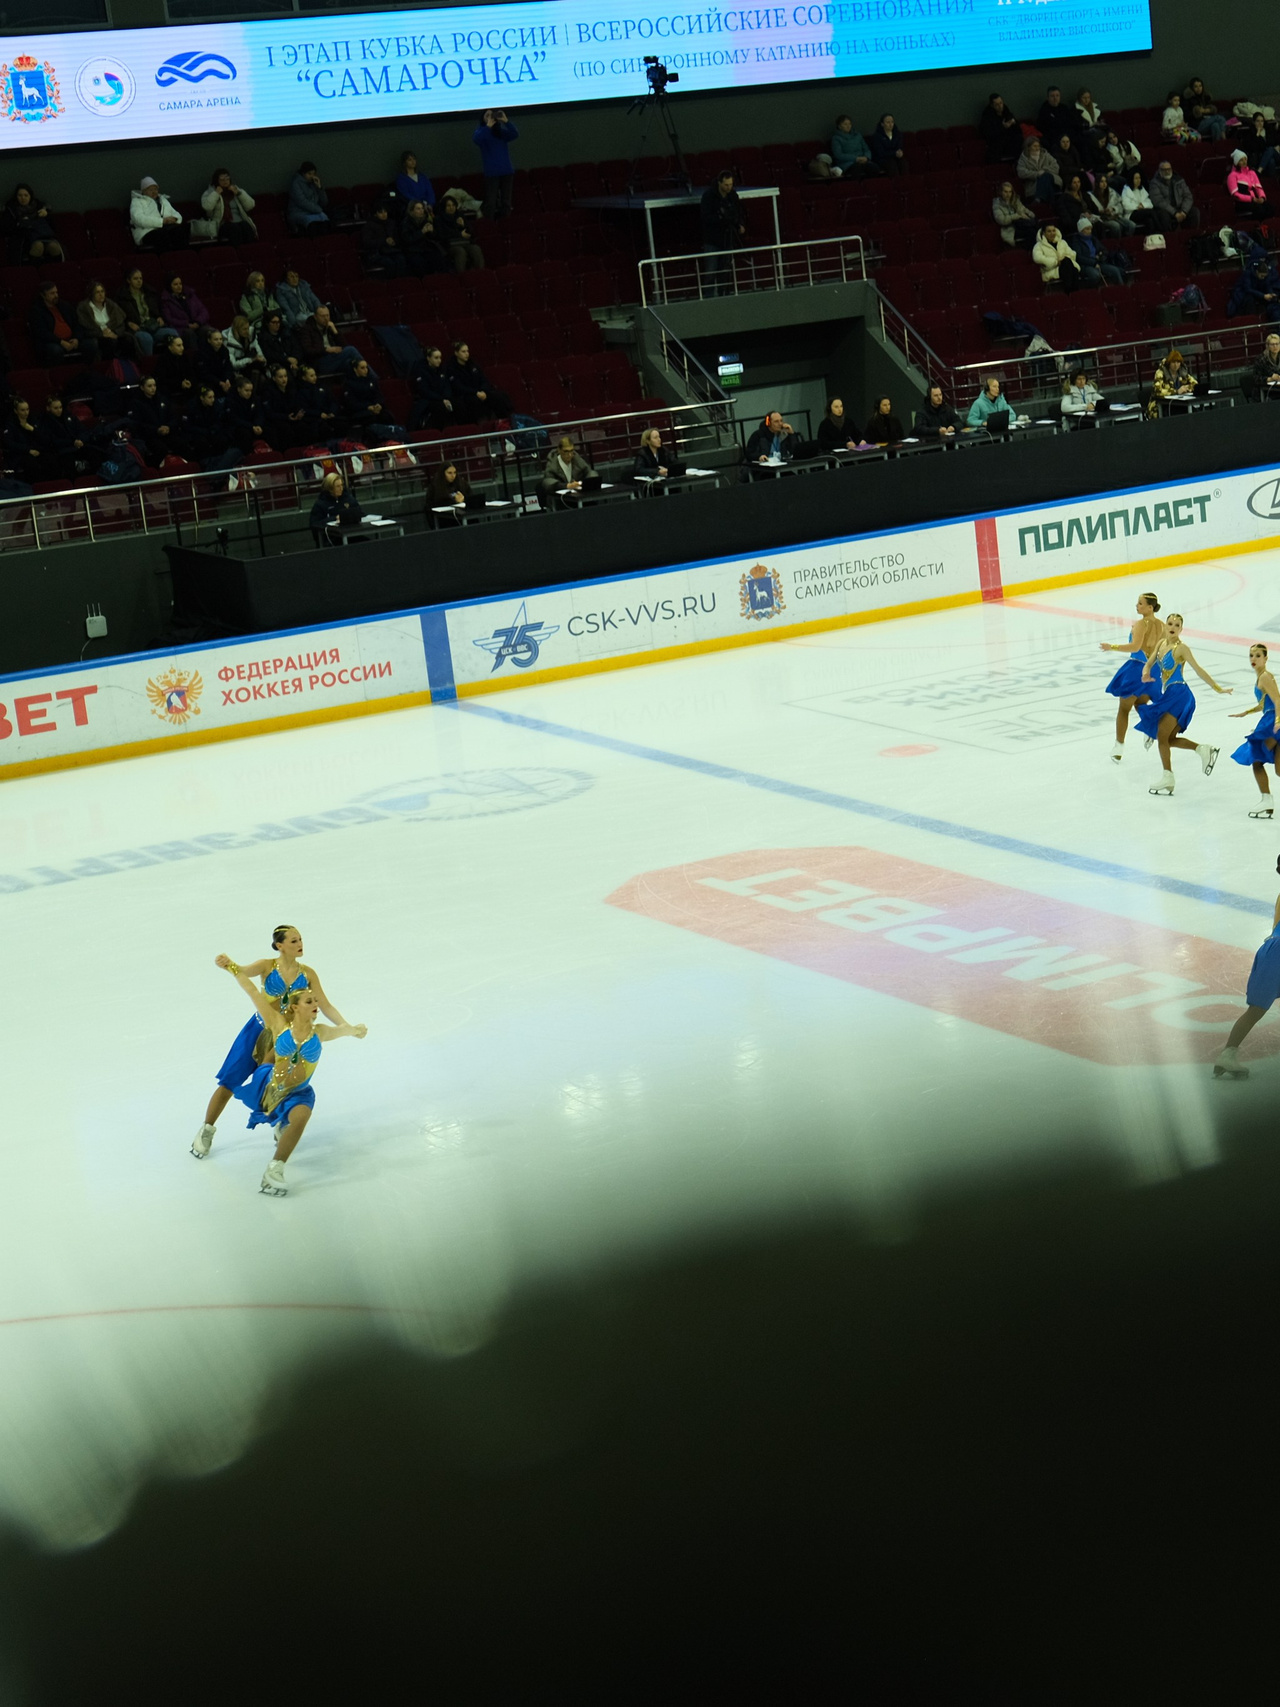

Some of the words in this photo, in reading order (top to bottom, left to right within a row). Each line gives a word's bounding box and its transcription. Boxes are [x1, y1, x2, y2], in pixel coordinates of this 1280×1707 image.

[576, 7, 787, 44] ВСЕРОССИЙСКИЕ
[793, 0, 975, 26] СОРЕВНОВАНИЯ
[1103, 4, 1143, 16] ИМЕНИ
[282, 40, 351, 65] ЭТАП
[360, 34, 445, 60] КУБКА
[451, 25, 557, 52] РОССИИ
[573, 58, 605, 79] (ПО
[610, 48, 750, 75] СИНРОННОМУ
[755, 40, 840, 62] КАТАНИЮ
[846, 39, 870, 55] НА
[874, 30, 956, 52] КОНЬКАХ)
[998, 28, 1066, 42] ВЛАДИМИРА
[159, 99, 204, 111] САМАРА
[206, 96, 242, 107] АРЕНА
[1018, 494, 1211, 556] ПОЛИПЛАСТ
[793, 552, 905, 584] ПРАВИТЕЛЬСТВО
[795, 571, 879, 600] САМАРСКОЙ
[882, 562, 945, 584] ОБЛАСТИ
[568, 592, 717, 636] CSK-VVS.RU
[217, 648, 341, 683] ФЕДЕРАЦИЯ
[491, 621, 545, 673] 75
[221, 676, 304, 706] ХОККЕЯ
[309, 661, 393, 690] РОССИИ
[924, 662, 1119, 711] АГАЗИН
